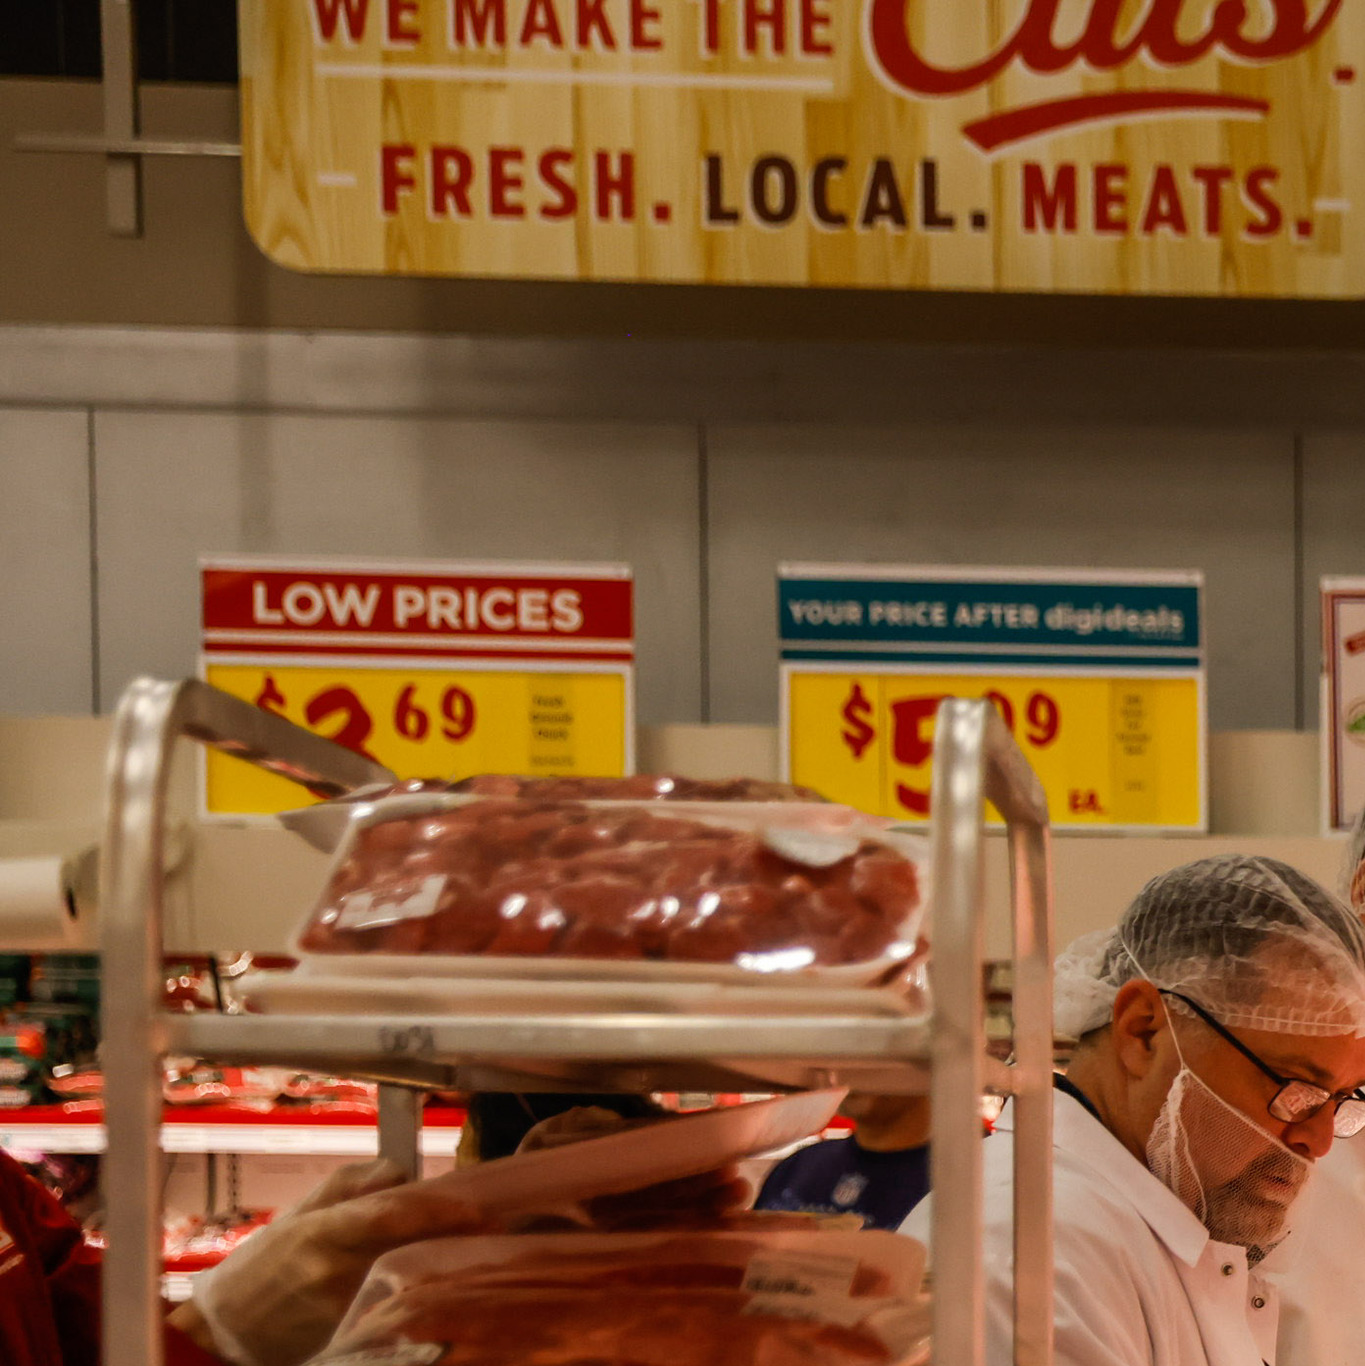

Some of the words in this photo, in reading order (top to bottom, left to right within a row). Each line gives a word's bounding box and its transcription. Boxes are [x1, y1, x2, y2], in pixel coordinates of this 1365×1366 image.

[314, 0, 422, 43] WE
[453, 0, 663, 50] MAKE
[705, 0, 834, 56] THE
[381, 144, 673, 224] FRESH.
[703, 152, 990, 232] LOCAL.
[1021, 162, 1314, 239] MEATS.
[253, 582, 380, 627] LOW
[393, 586, 584, 632] PRICES
[789, 600, 862, 626] YOUR
[869, 601, 947, 628] PRICE
[954, 603, 1039, 629] AFTER
[1045, 603, 1184, 635] digideals
